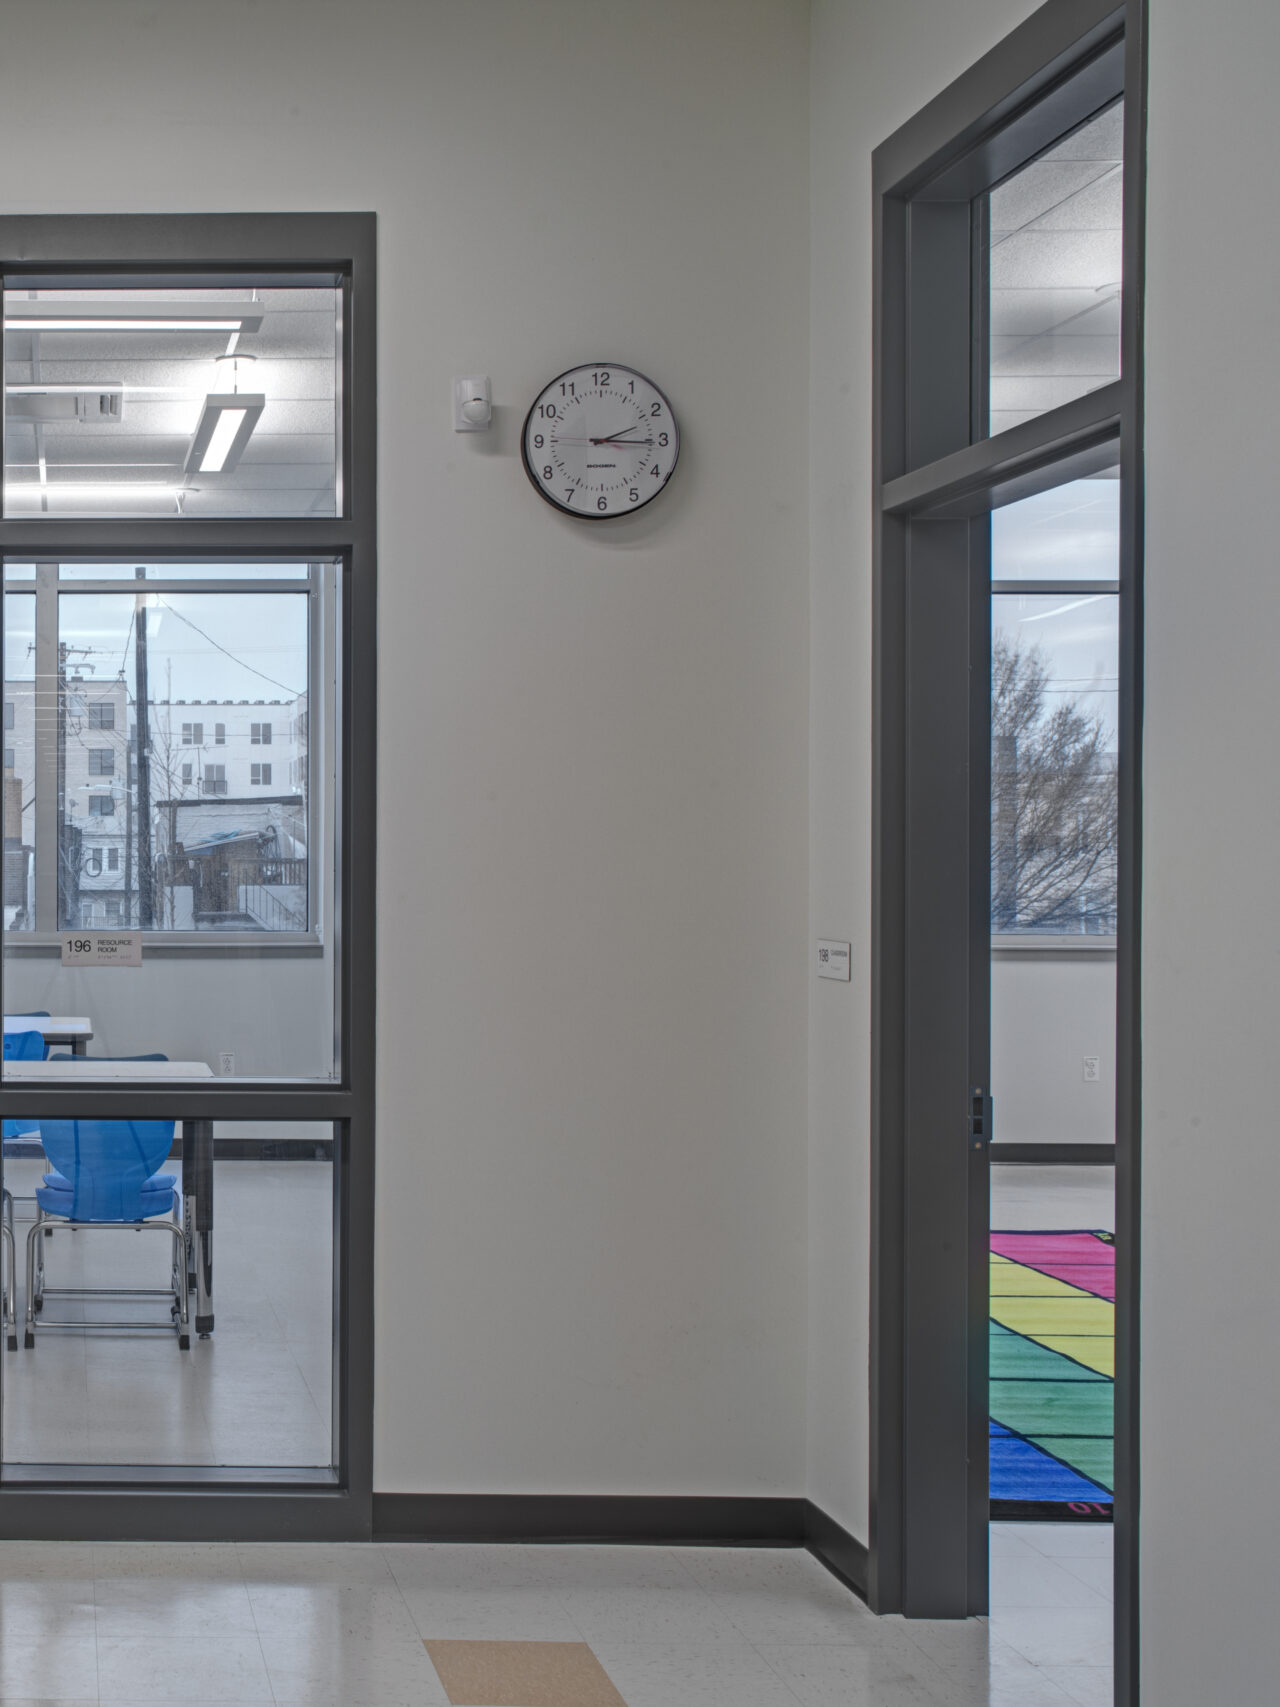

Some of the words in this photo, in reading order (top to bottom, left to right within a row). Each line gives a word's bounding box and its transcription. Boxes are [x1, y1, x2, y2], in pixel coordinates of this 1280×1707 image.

[592, 372, 610, 386] 12
[559, 382, 575, 396] 11
[628, 380, 635, 394] 1
[538, 404, 556, 418] 10
[651, 403, 661, 417] 2
[534, 434, 544, 448] 9
[658, 432, 669, 447] 3
[543, 465, 553, 480] 8
[650, 464, 660, 478] 4
[565, 489, 575, 503] 7
[629, 488, 639, 502] 5
[597, 496, 607, 511] 6
[67, 940, 91, 953] 196
